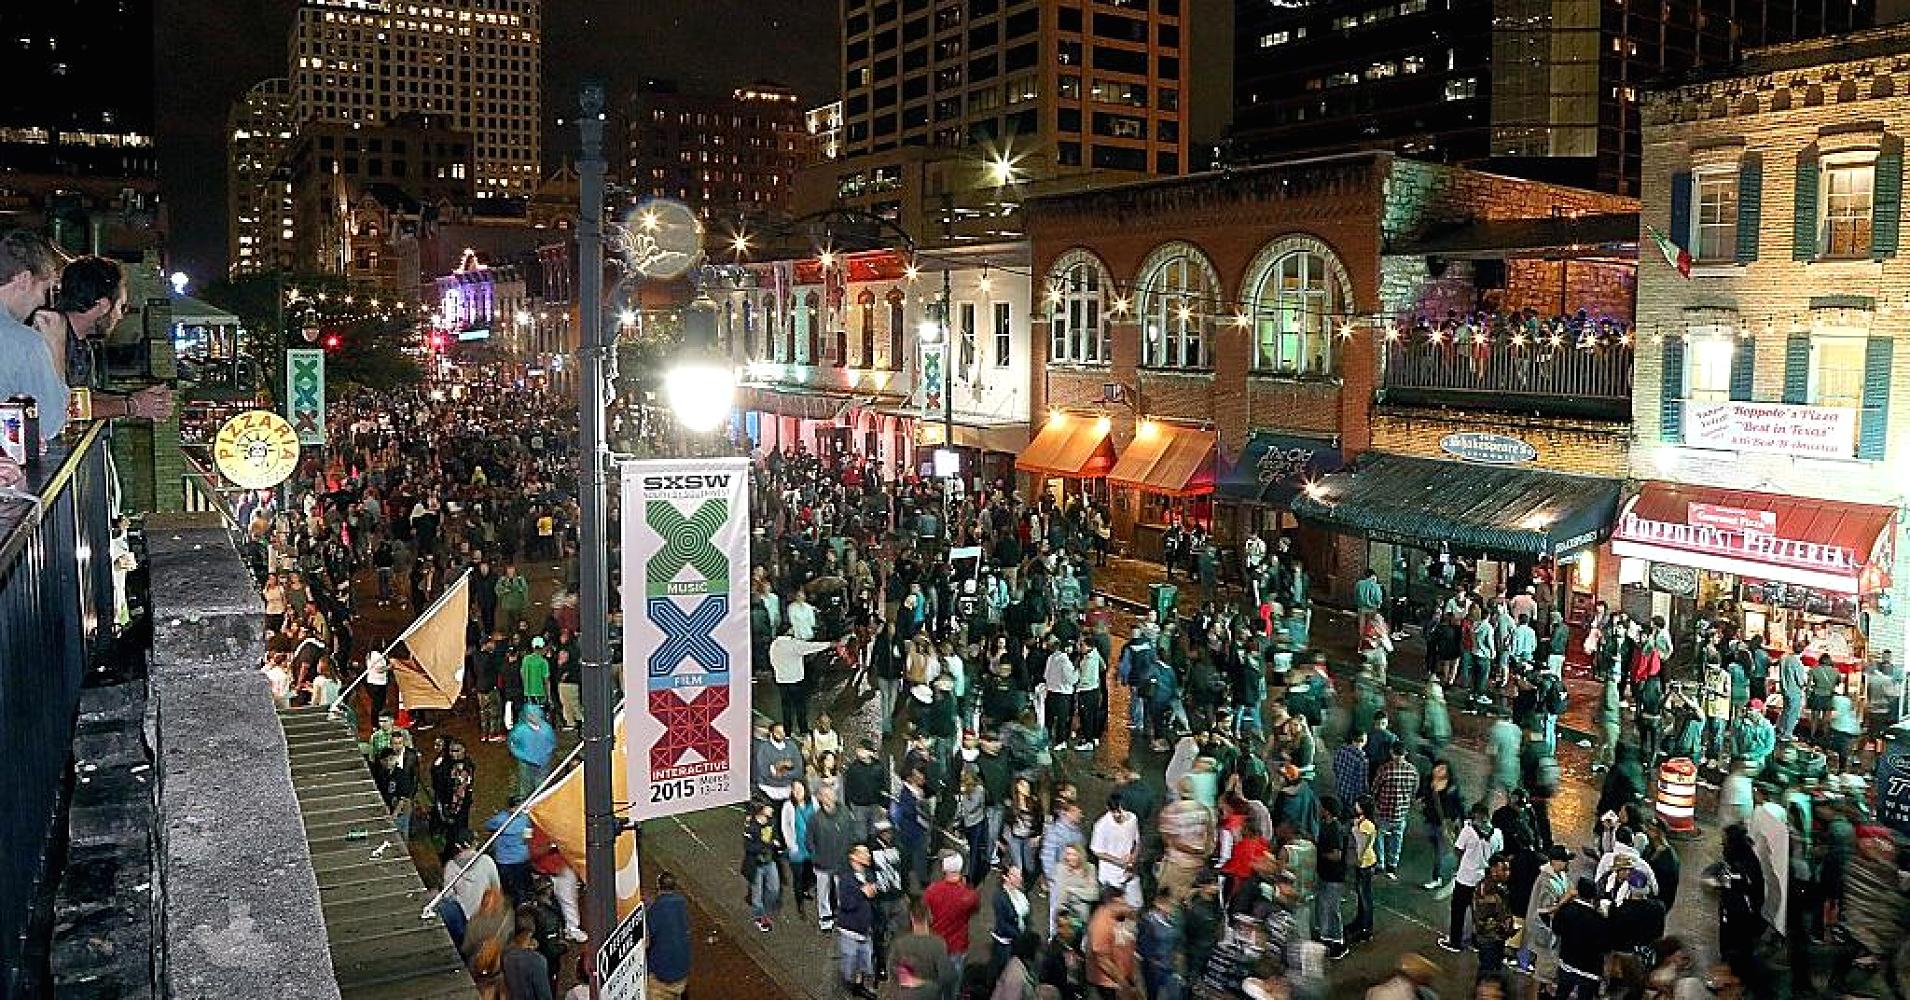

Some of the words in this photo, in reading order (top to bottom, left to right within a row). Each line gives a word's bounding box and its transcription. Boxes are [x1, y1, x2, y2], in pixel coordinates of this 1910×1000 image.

[219, 414, 296, 460] PIZZARIA
[643, 475, 731, 490] SXSW
[667, 582, 708, 594] MUSIC
[674, 675, 703, 686] FILM
[652, 762, 728, 780] INTERACTIVE
[650, 780, 695, 802] 2015
[699, 774, 729, 785] March
